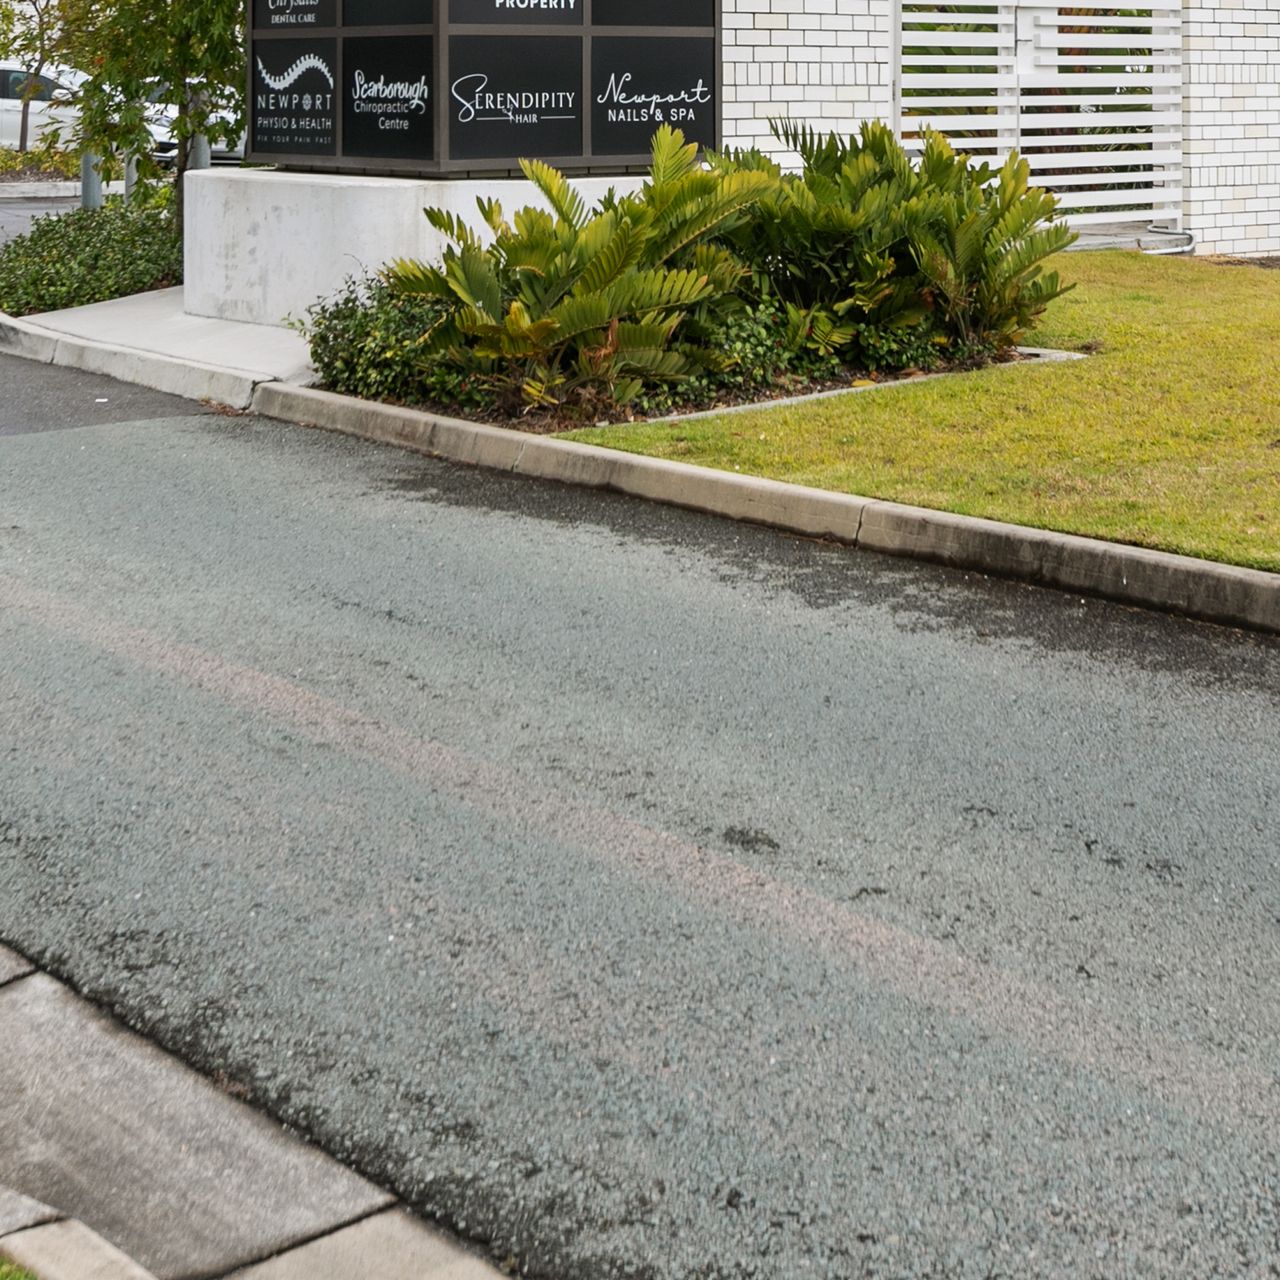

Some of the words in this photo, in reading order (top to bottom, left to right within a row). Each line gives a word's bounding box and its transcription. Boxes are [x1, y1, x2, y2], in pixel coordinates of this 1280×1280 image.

[271, 14, 297, 24] DENTAL
[298, 13, 316, 23] CARE
[352, 69, 429, 115] Scarborough
[596, 72, 712, 116] Newport
[353, 100, 409, 114] Chiropractic
[515, 113, 538, 124] HAIR
[608, 108, 648, 122] NAILS
[654, 108, 664, 122] &
[670, 108, 696, 121] SPA
[257, 117, 288, 129] PHYSIO
[290, 119, 297, 129] &
[299, 117, 332, 129] HEALTH
[378, 117, 409, 130] Centre
[272, 135, 290, 143] YOUR
[294, 135, 310, 143] PAIN
[315, 135, 332, 144] FAST
